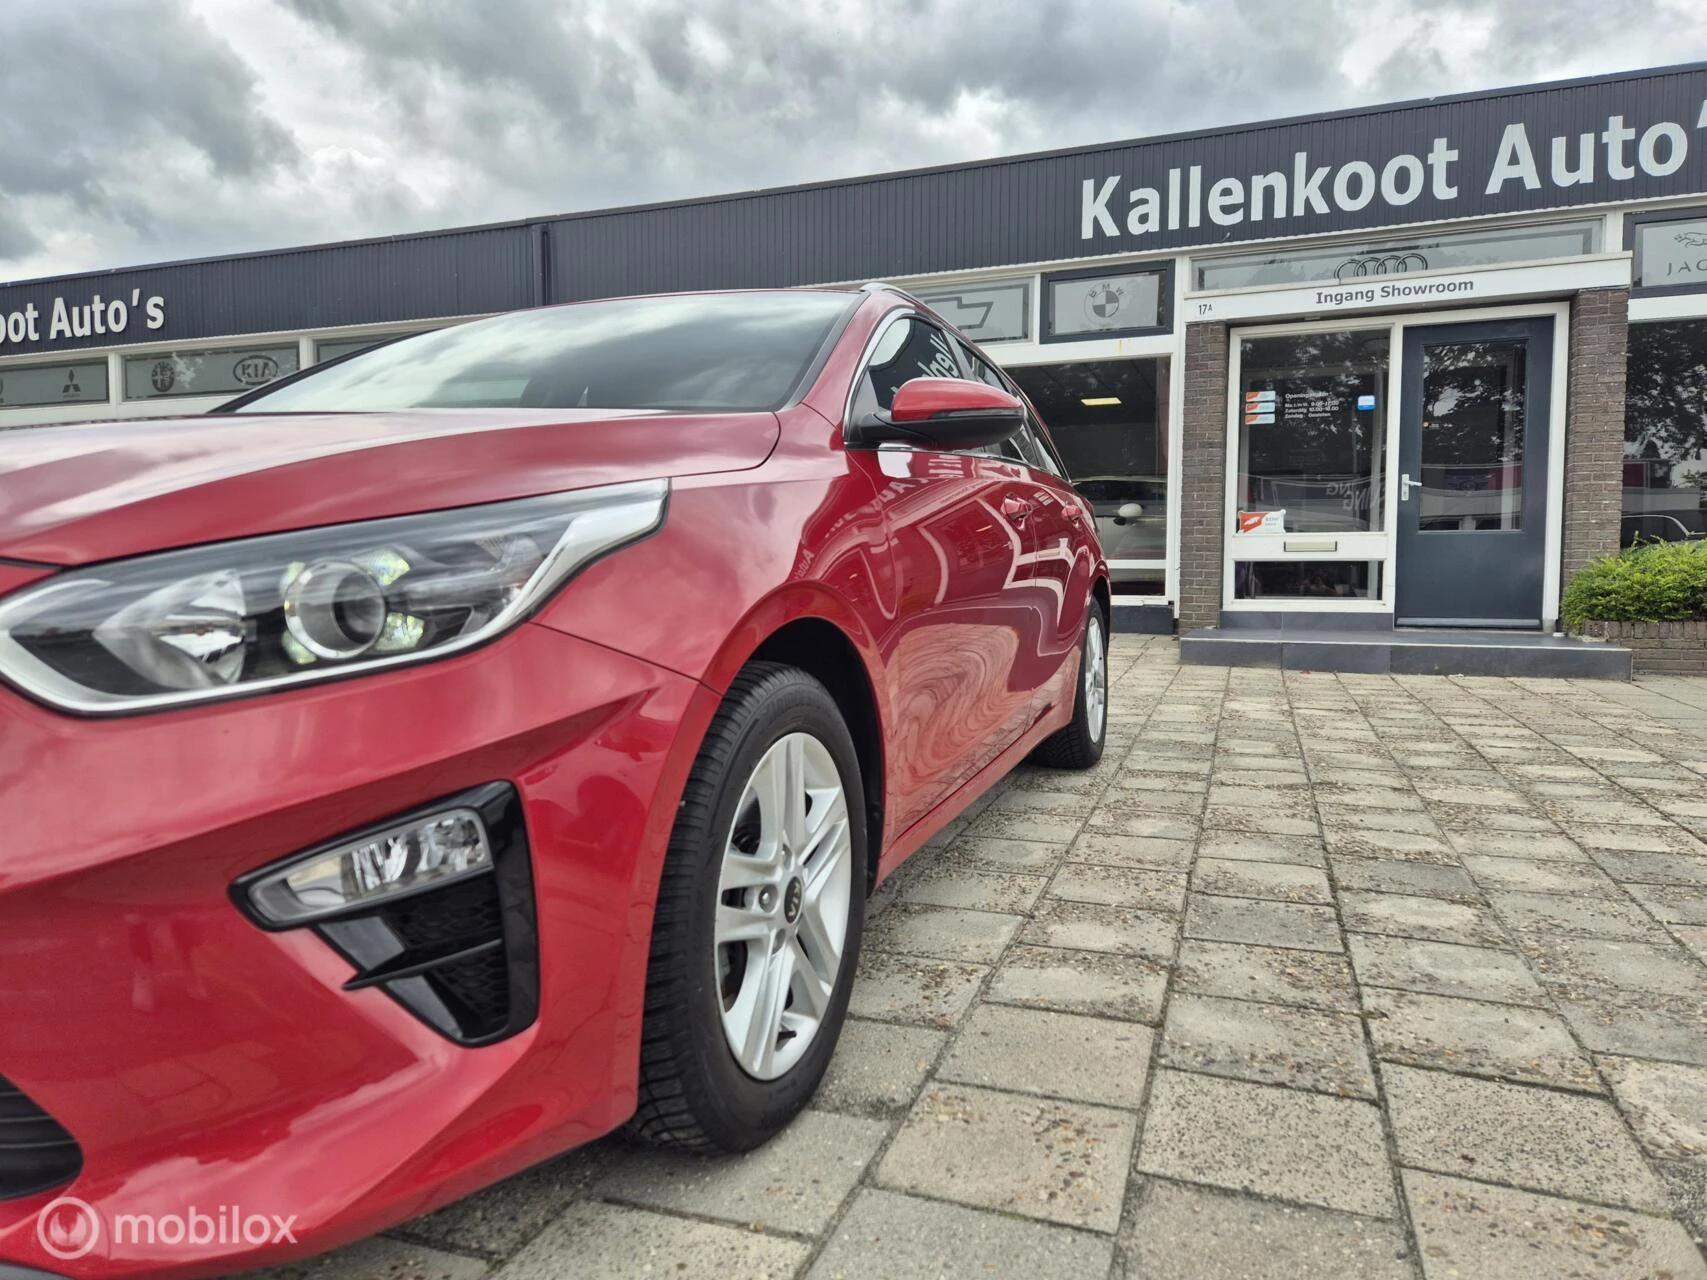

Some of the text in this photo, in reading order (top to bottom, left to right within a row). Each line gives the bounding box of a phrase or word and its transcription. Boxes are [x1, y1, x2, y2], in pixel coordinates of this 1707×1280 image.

[1081, 137, 1459, 240] Kallenkoot
[1316, 280, 1474, 305] Ingang Showroom
[49, 288, 165, 340] Auto's
[1198, 303, 1214, 316] 17A
[241, 362, 271, 379] KIA
